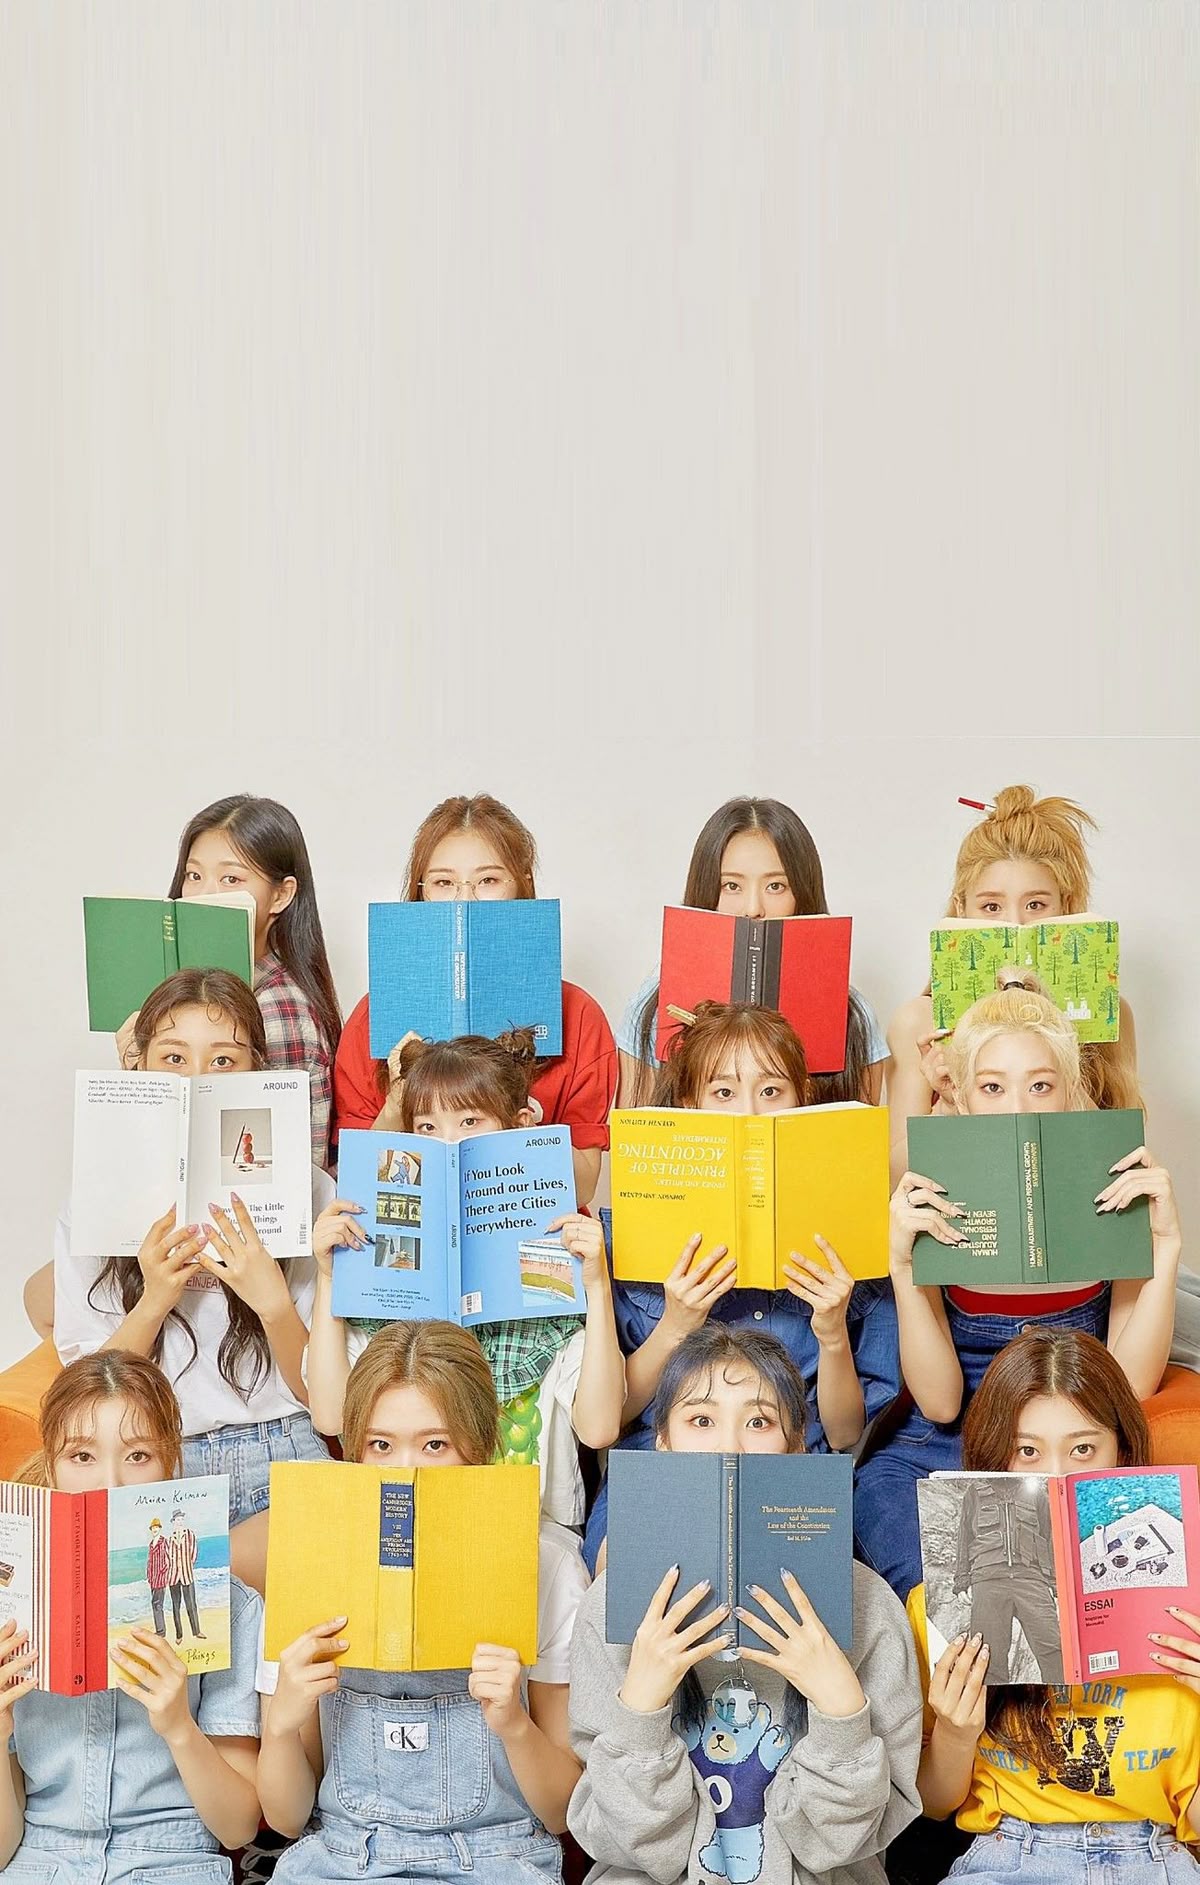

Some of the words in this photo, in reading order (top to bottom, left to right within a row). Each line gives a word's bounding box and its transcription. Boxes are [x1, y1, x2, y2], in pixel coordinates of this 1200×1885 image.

[263, 1081, 298, 1091] AROUND
[526, 1137, 561, 1148] AROUND
[619, 1143, 726, 1162] ACCOUNTING
[464, 1170, 470, 1183] If
[472, 1169, 491, 1181] You
[495, 1163, 525, 1177] Look
[630, 1161, 648, 1173] OF
[652, 1162, 727, 1177] PRINCIPLES
[465, 1182, 504, 1201] Around
[508, 1183, 529, 1193] our
[534, 1178, 568, 1192] Lives,
[265, 1202, 285, 1211] Little
[465, 1204, 494, 1218] There
[498, 1201, 518, 1212] are
[521, 1196, 556, 1210] Cities
[253, 1215, 278, 1224] Things
[466, 1217, 537, 1236] Everywhere.
[1084, 1598, 1114, 1612] ESSAI
[185, 1648, 216, 1665] Things
[1083, 1682, 1128, 1709] YORK
